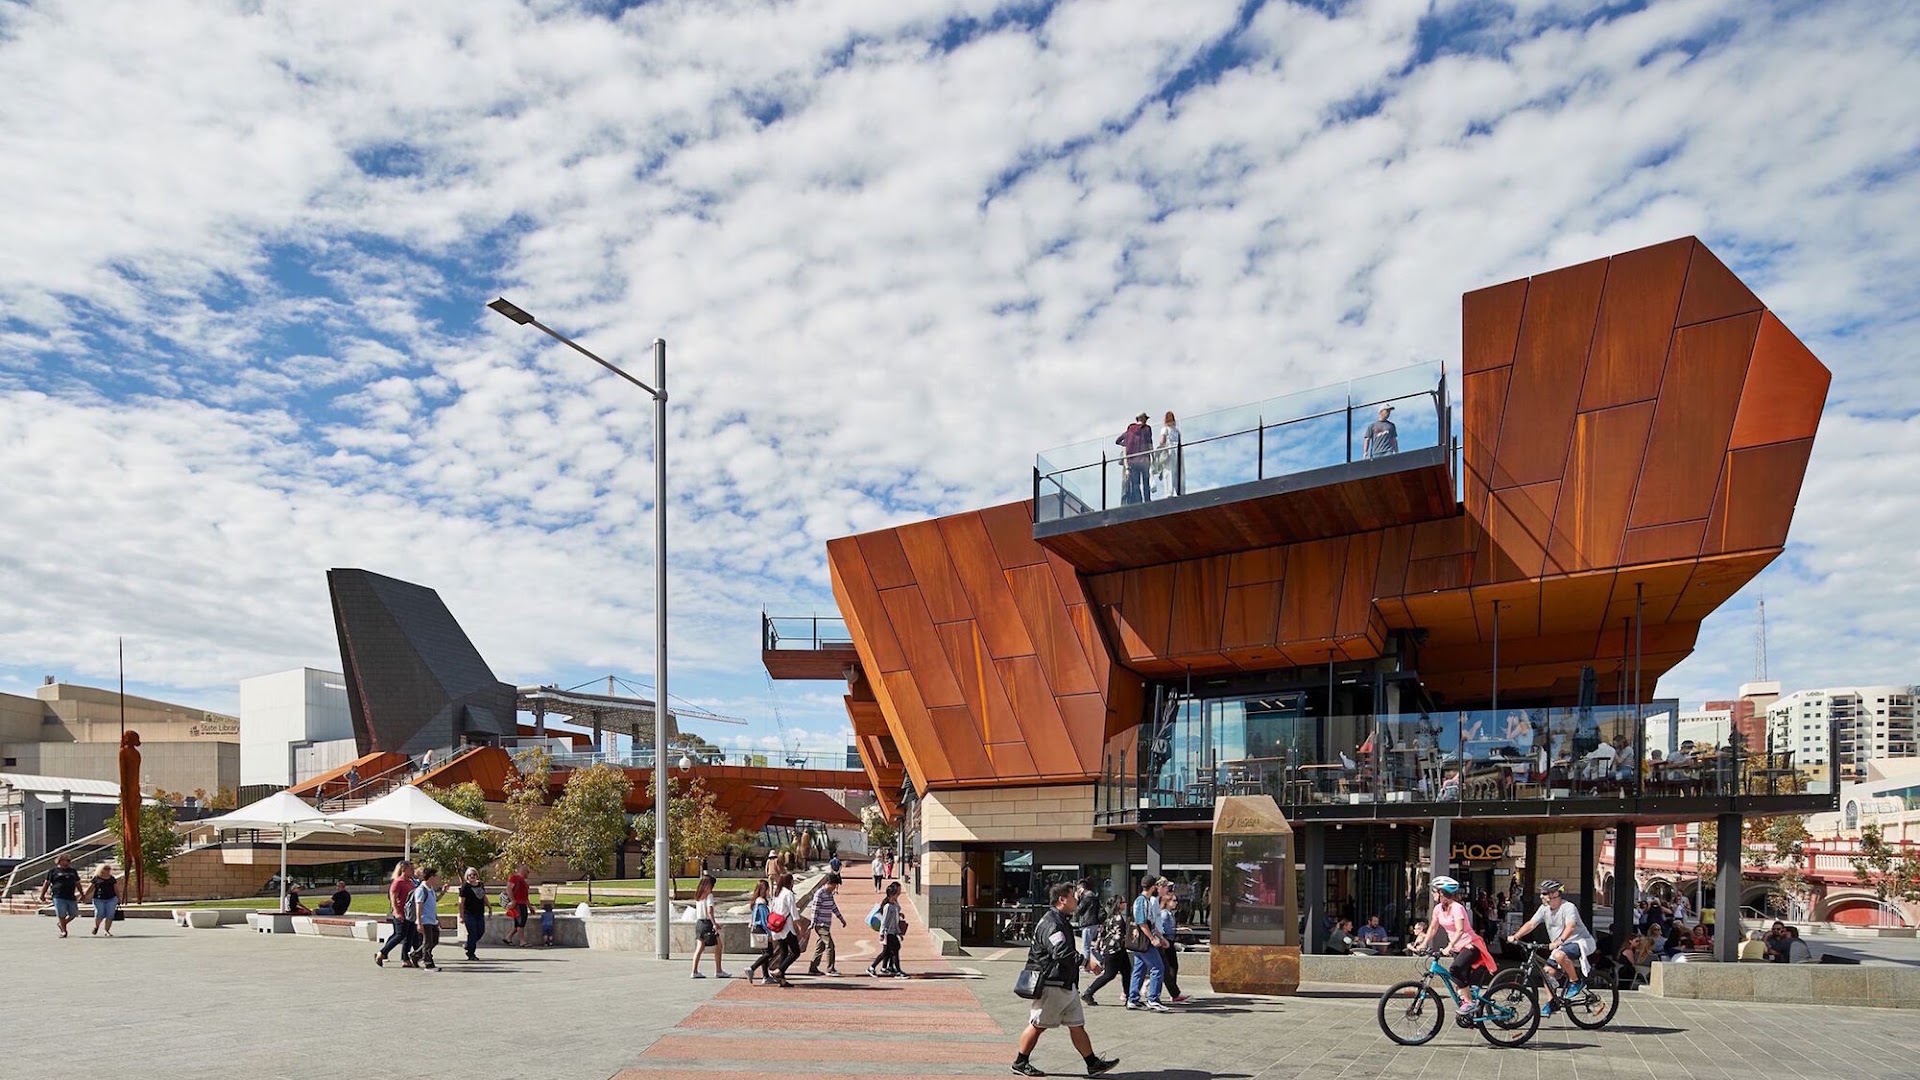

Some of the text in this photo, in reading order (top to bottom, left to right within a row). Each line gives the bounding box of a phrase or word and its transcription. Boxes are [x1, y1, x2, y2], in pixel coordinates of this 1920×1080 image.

[200, 724, 217, 732] State
[218, 724, 240, 733] Library
[1226, 840, 1243, 848] MAP
